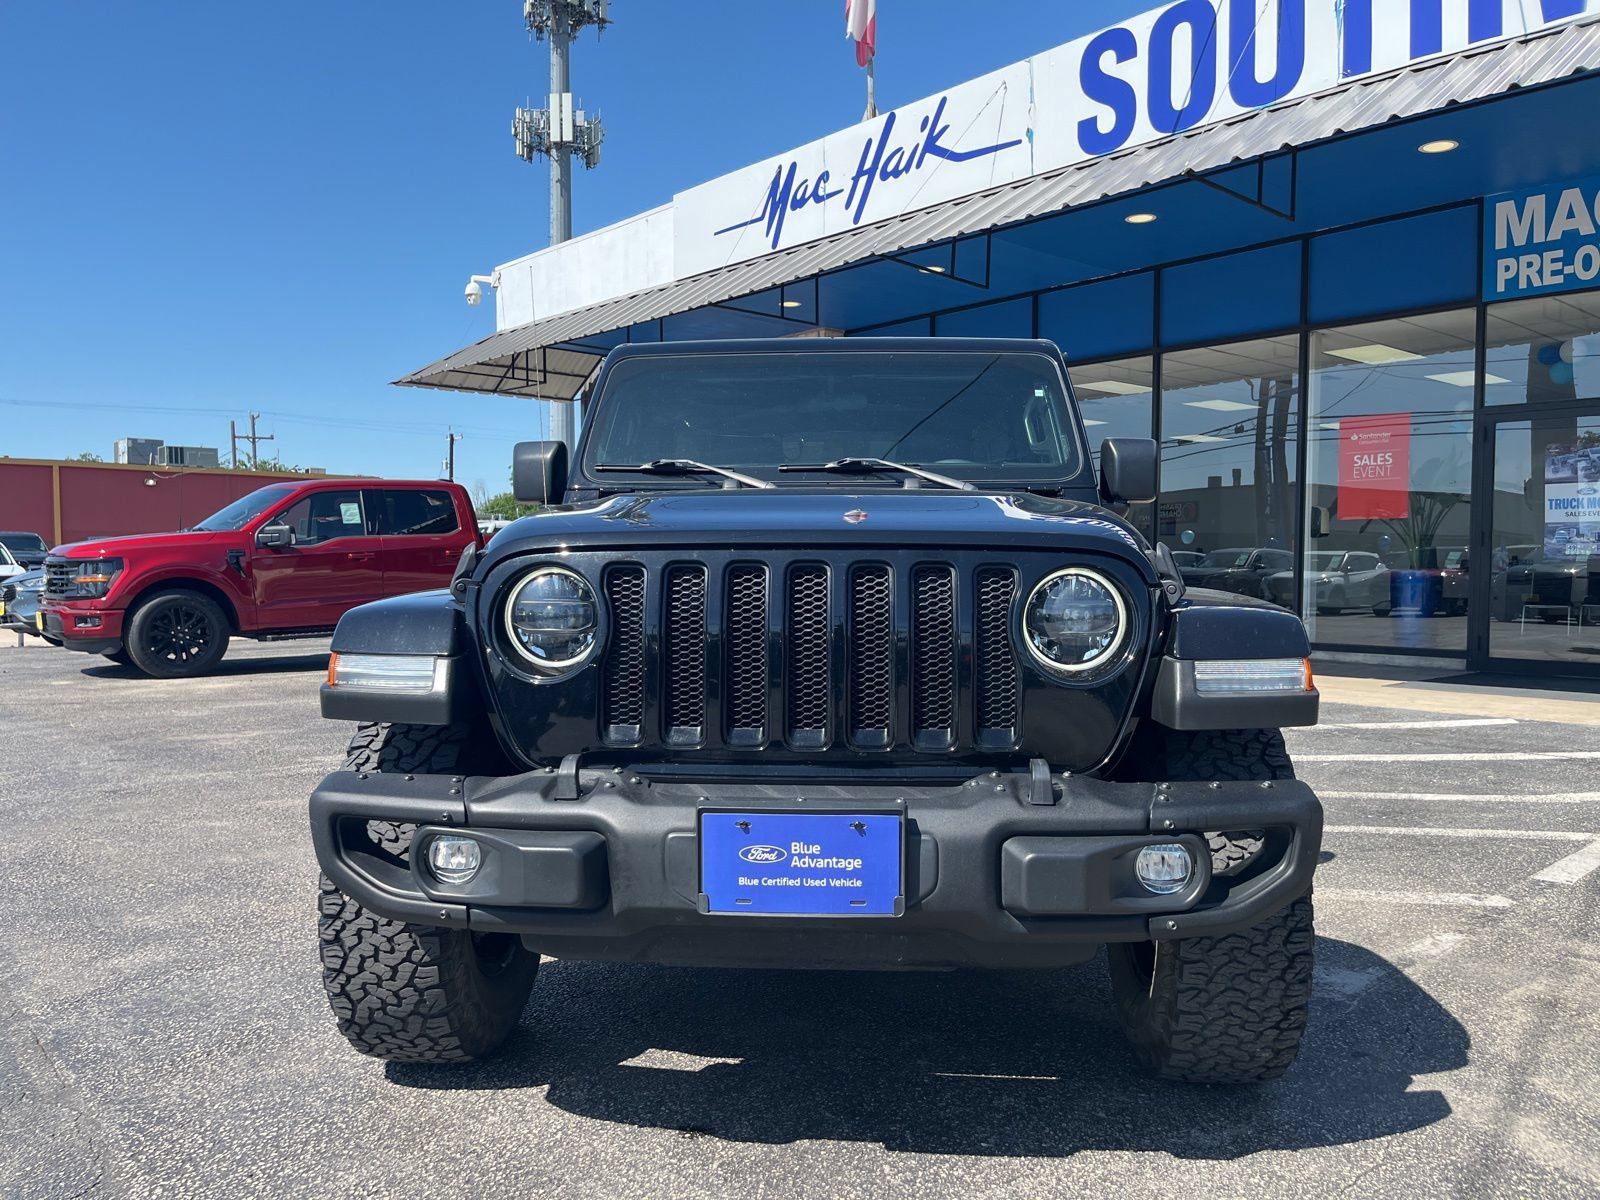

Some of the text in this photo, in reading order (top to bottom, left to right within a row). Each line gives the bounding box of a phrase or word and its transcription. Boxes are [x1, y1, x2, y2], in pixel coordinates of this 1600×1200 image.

[714, 96, 1022, 250] Mac Haik
[1495, 187, 1600, 250] MA
[1353, 452, 1393, 467] SALES
[1353, 465, 1393, 478] EVENT
[1548, 497, 1585, 510] TRUCK
[747, 847, 778, 860] Ford
[791, 842, 821, 855] Blue
[790, 855, 863, 871] Advantage
[738, 876, 863, 888] Blue Certified Used Vehicle
